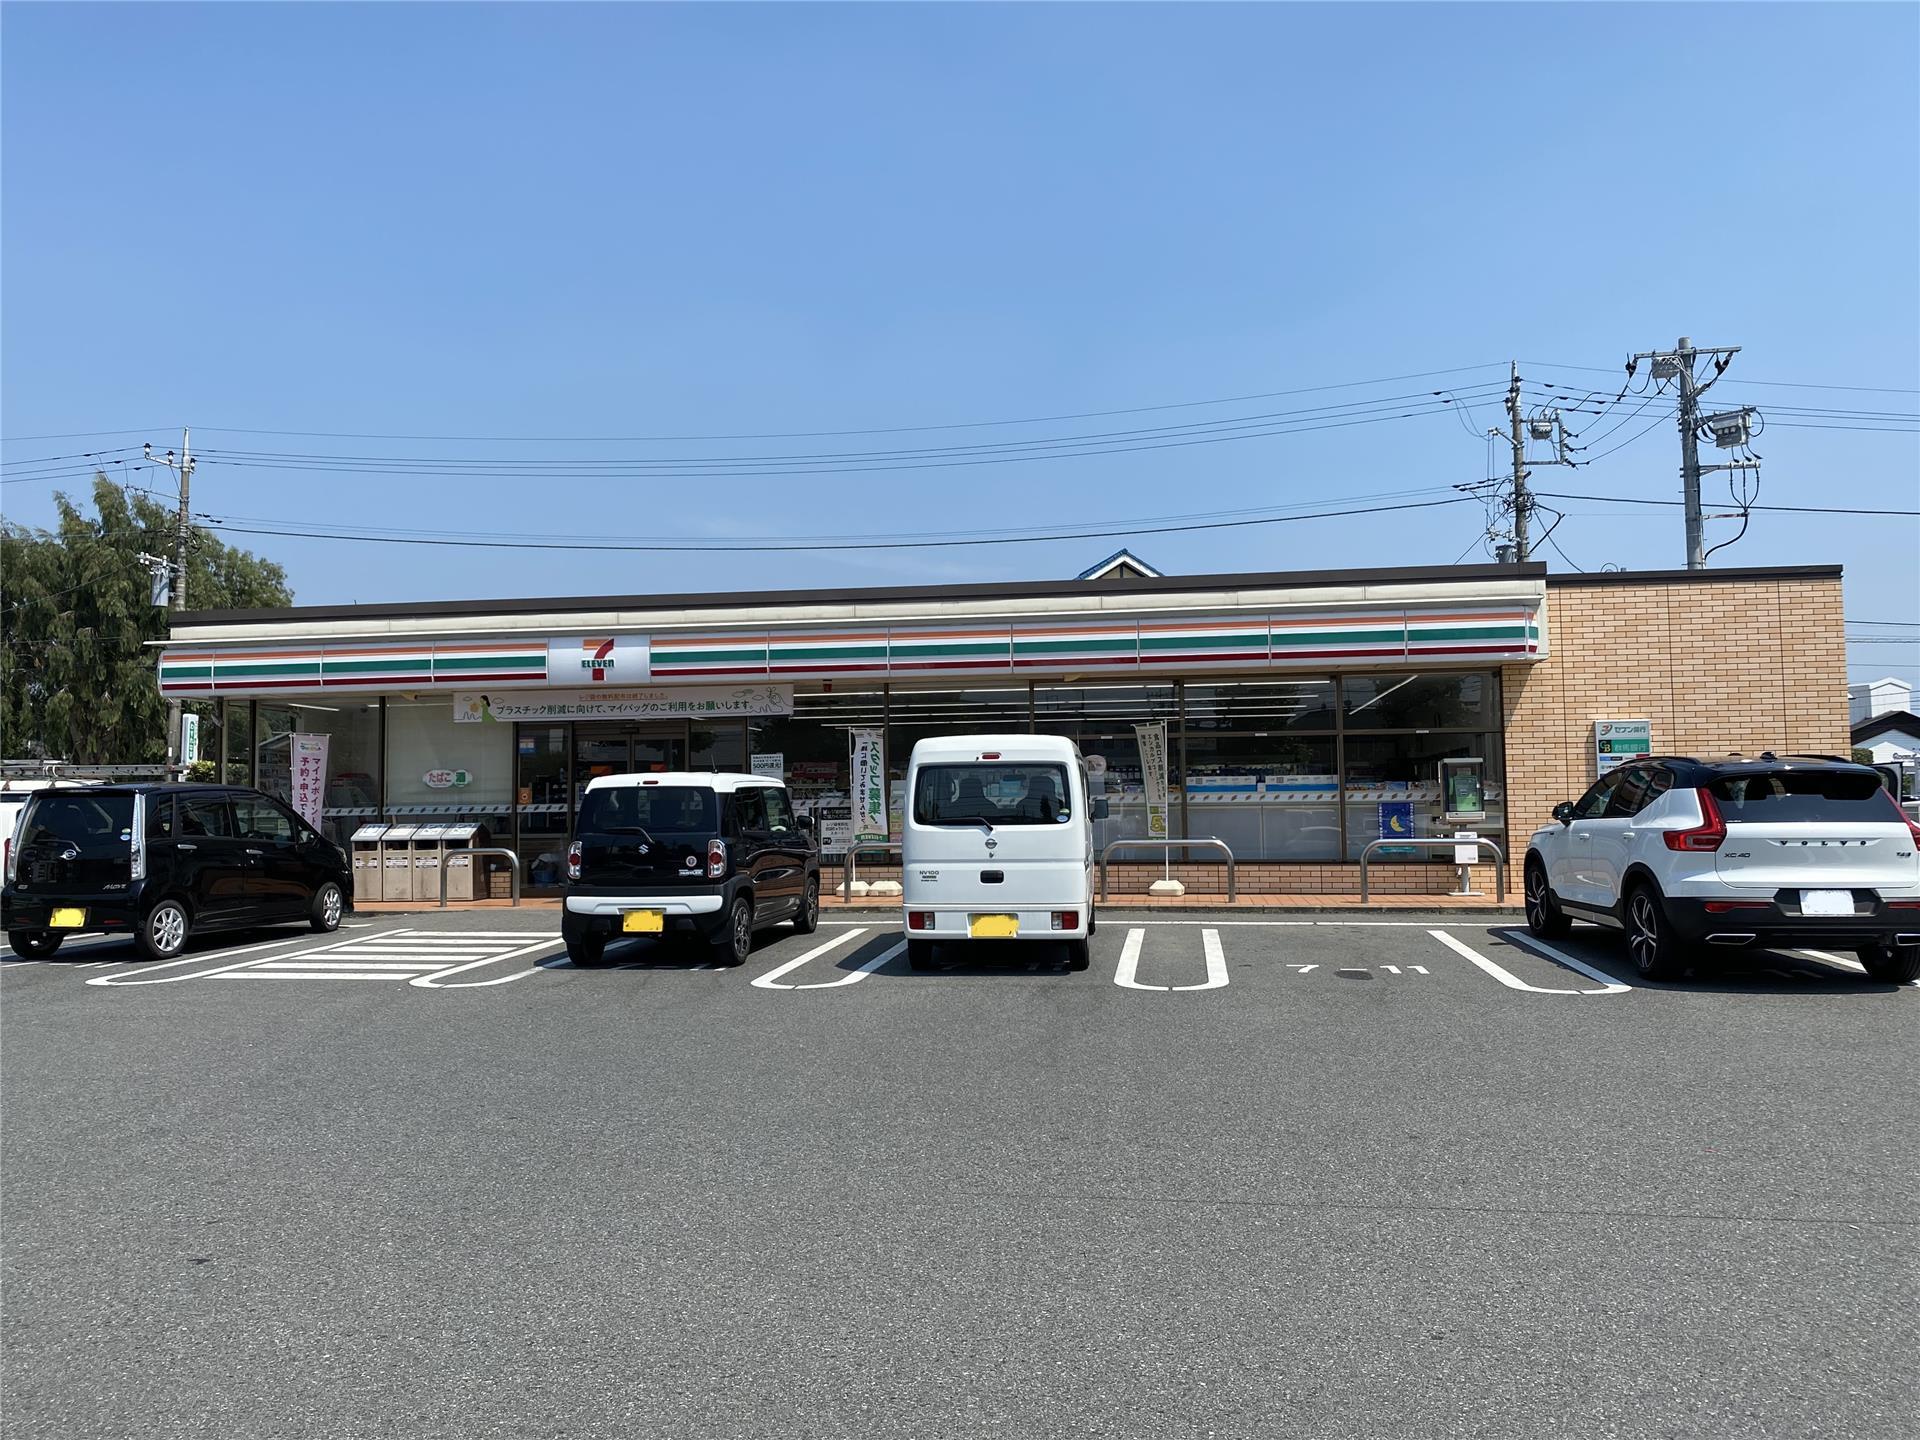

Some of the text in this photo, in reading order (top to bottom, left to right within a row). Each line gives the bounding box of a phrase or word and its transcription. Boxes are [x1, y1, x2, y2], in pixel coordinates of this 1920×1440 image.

[497, 698, 753, 716] プラスチック削減に向けて、マイバッグのご利用をお願いします。
[1614, 726, 1647, 734] セブン銀行
[311, 757, 321, 826] マイナポイント
